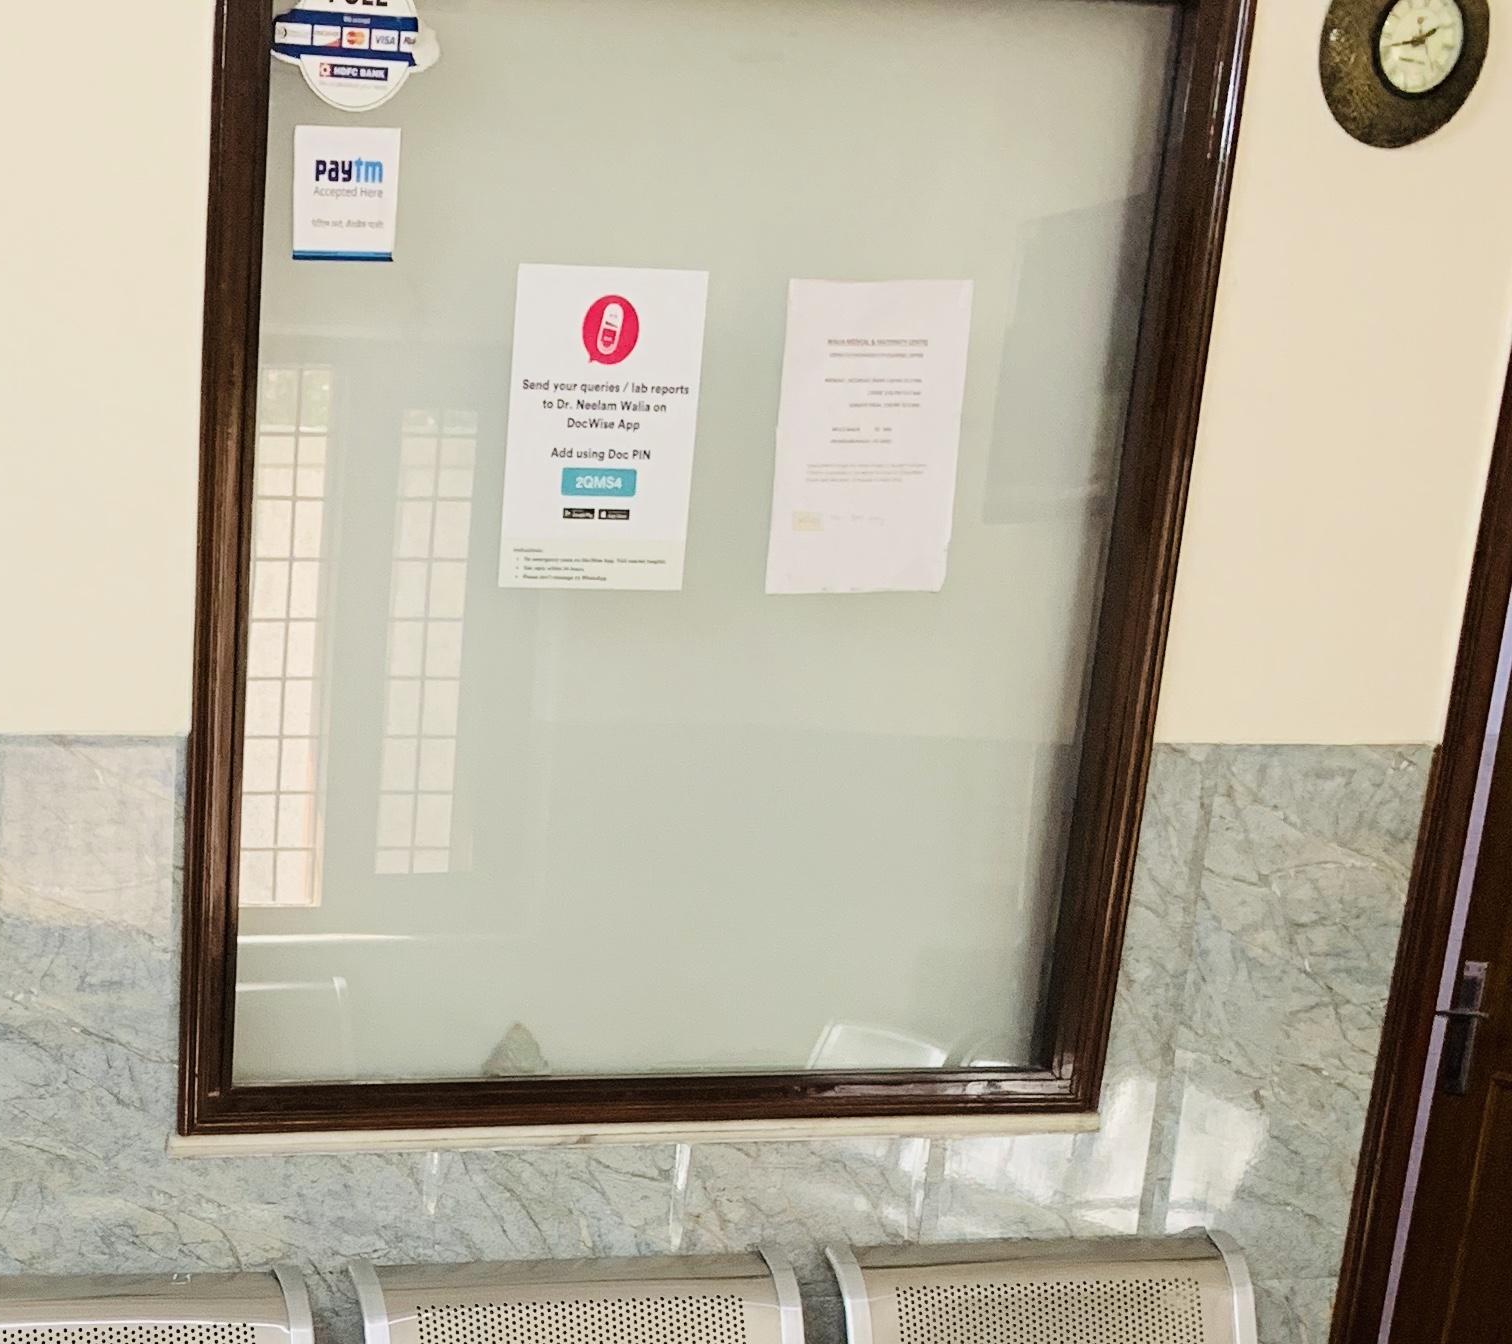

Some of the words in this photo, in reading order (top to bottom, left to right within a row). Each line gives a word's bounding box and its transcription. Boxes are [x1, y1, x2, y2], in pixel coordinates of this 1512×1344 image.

[375, 35, 396, 46] VISA
[359, 67, 386, 79] BANK
[314, 156, 384, 183] paytm
[313, 186, 357, 199] Accepted
[360, 187, 384, 198] Here
[522, 379, 550, 391] Send
[553, 383, 578, 393] your
[580, 381, 620, 394] queries
[631, 382, 648, 393] lab
[651, 385, 690, 396] reports
[542, 400, 554, 409] to
[557, 399, 573, 409] Dr.
[576, 400, 617, 411] Neelam
[653, 404, 667, 413] on
[567, 417, 615, 429] DocWise
[617, 419, 641, 432] App
[551, 447, 574, 458] Add
[576, 448, 606, 461] using
[608, 449, 629, 460] Doc
[632, 449, 651, 460] PIN
